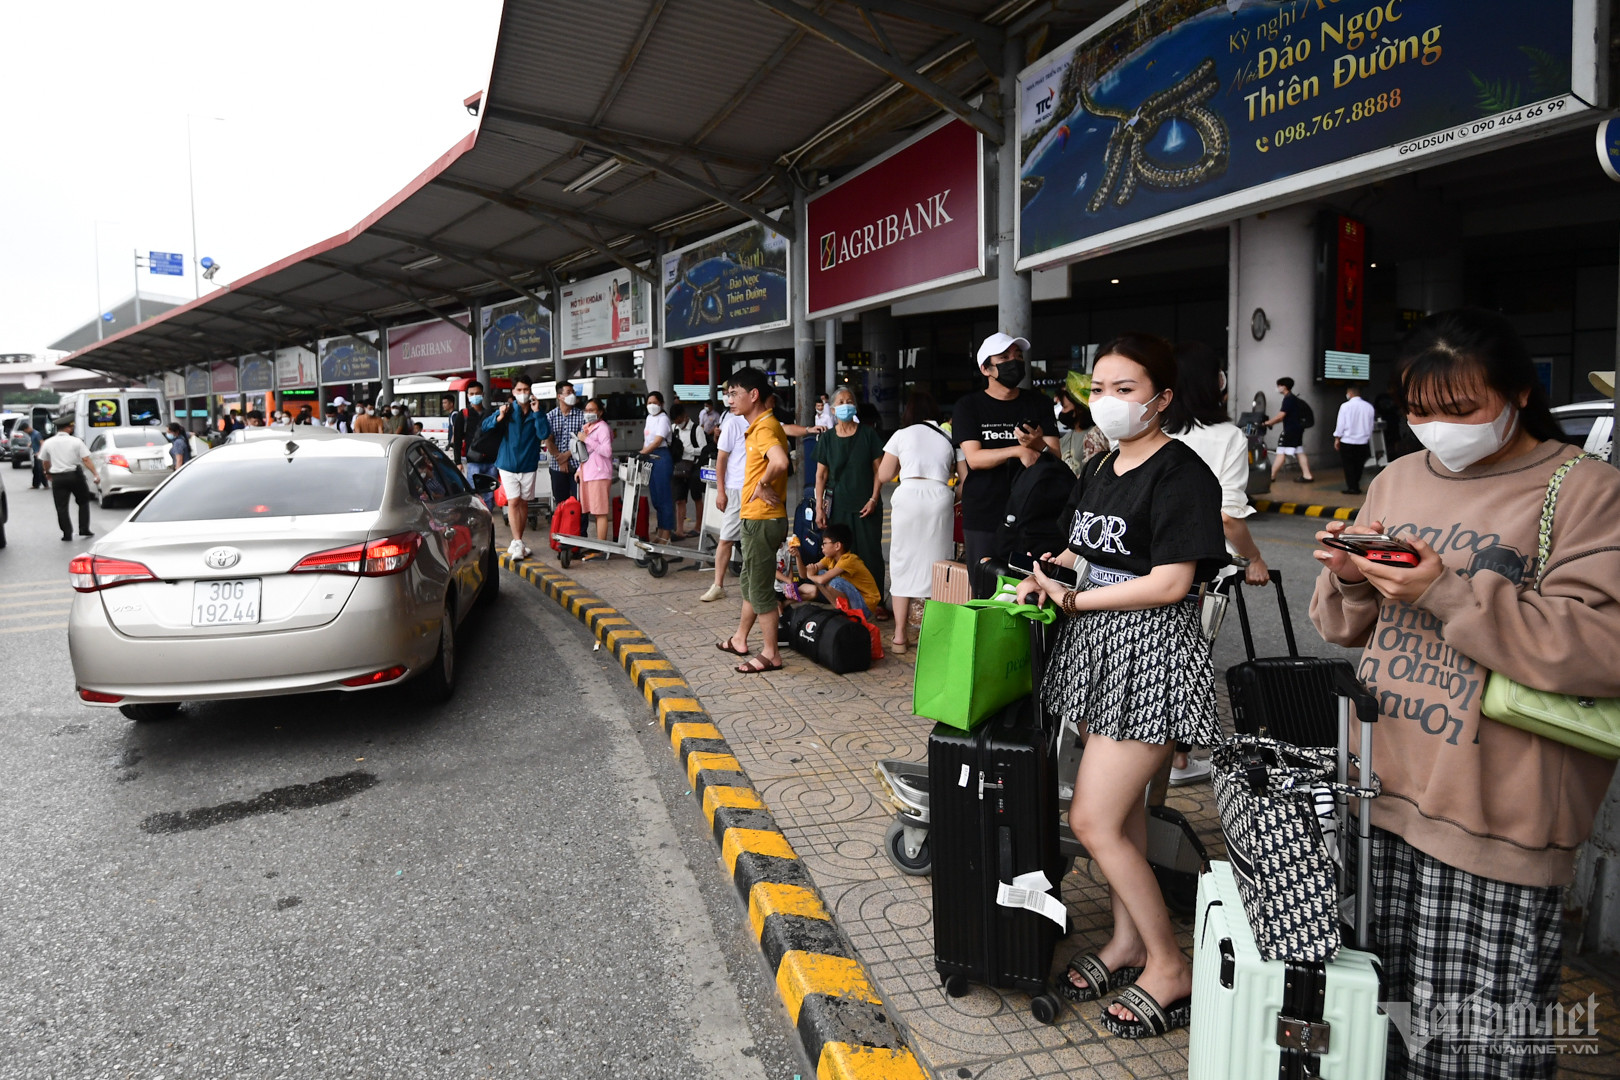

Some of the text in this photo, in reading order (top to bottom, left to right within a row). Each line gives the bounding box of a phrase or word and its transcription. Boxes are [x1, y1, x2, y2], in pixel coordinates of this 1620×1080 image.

[1229, 28, 1250, 54] Kỳ
[1256, 1, 1297, 41] nghỉ
[1257, 34, 1311, 80] Đảo
[1320, 0, 1402, 52] Ngọc
[1244, 24, 1443, 122] Thiên Đường
[1036, 96, 1052, 115] TTC
[1274, 88, 1402, 148] 098.767.8888
[1399, 99, 1565, 155] GOLDSUN 090 464 66 99
[837, 189, 954, 264] AGRIBANK
[411, 339, 452, 360] AGRIBANK
[197, 601, 256, 624] 192.44
[209, 582, 244, 601] 30G
[1138, 1001, 1155, 1019] DIOR
